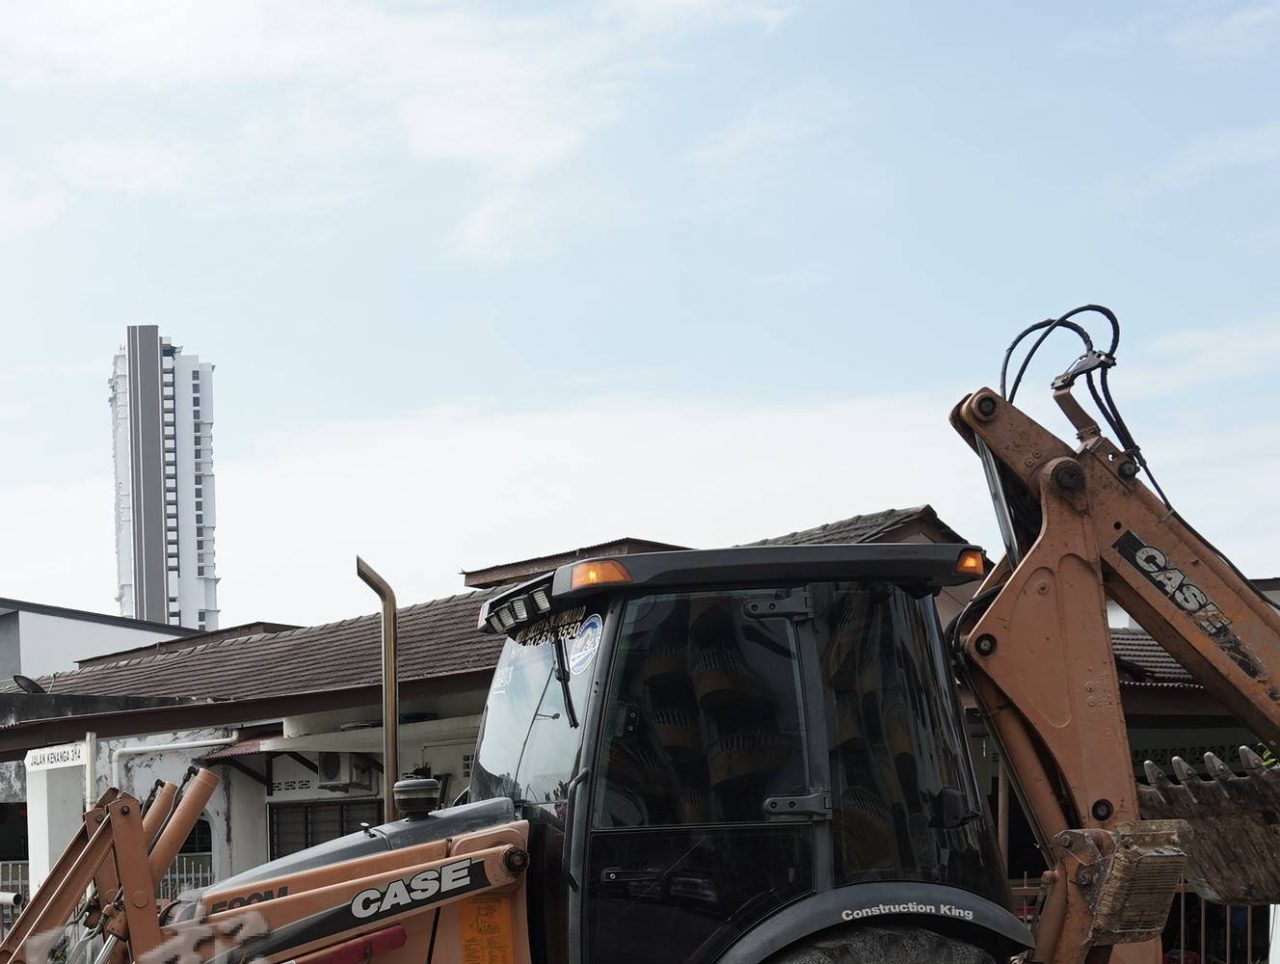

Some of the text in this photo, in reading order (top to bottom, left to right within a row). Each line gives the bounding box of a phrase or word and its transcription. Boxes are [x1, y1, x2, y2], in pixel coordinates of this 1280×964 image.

[31, 754, 46, 766] JALAN
[47, 750, 70, 764] KENANGA
[351, 858, 472, 919] CASE
[841, 902, 973, 921] Construction King
